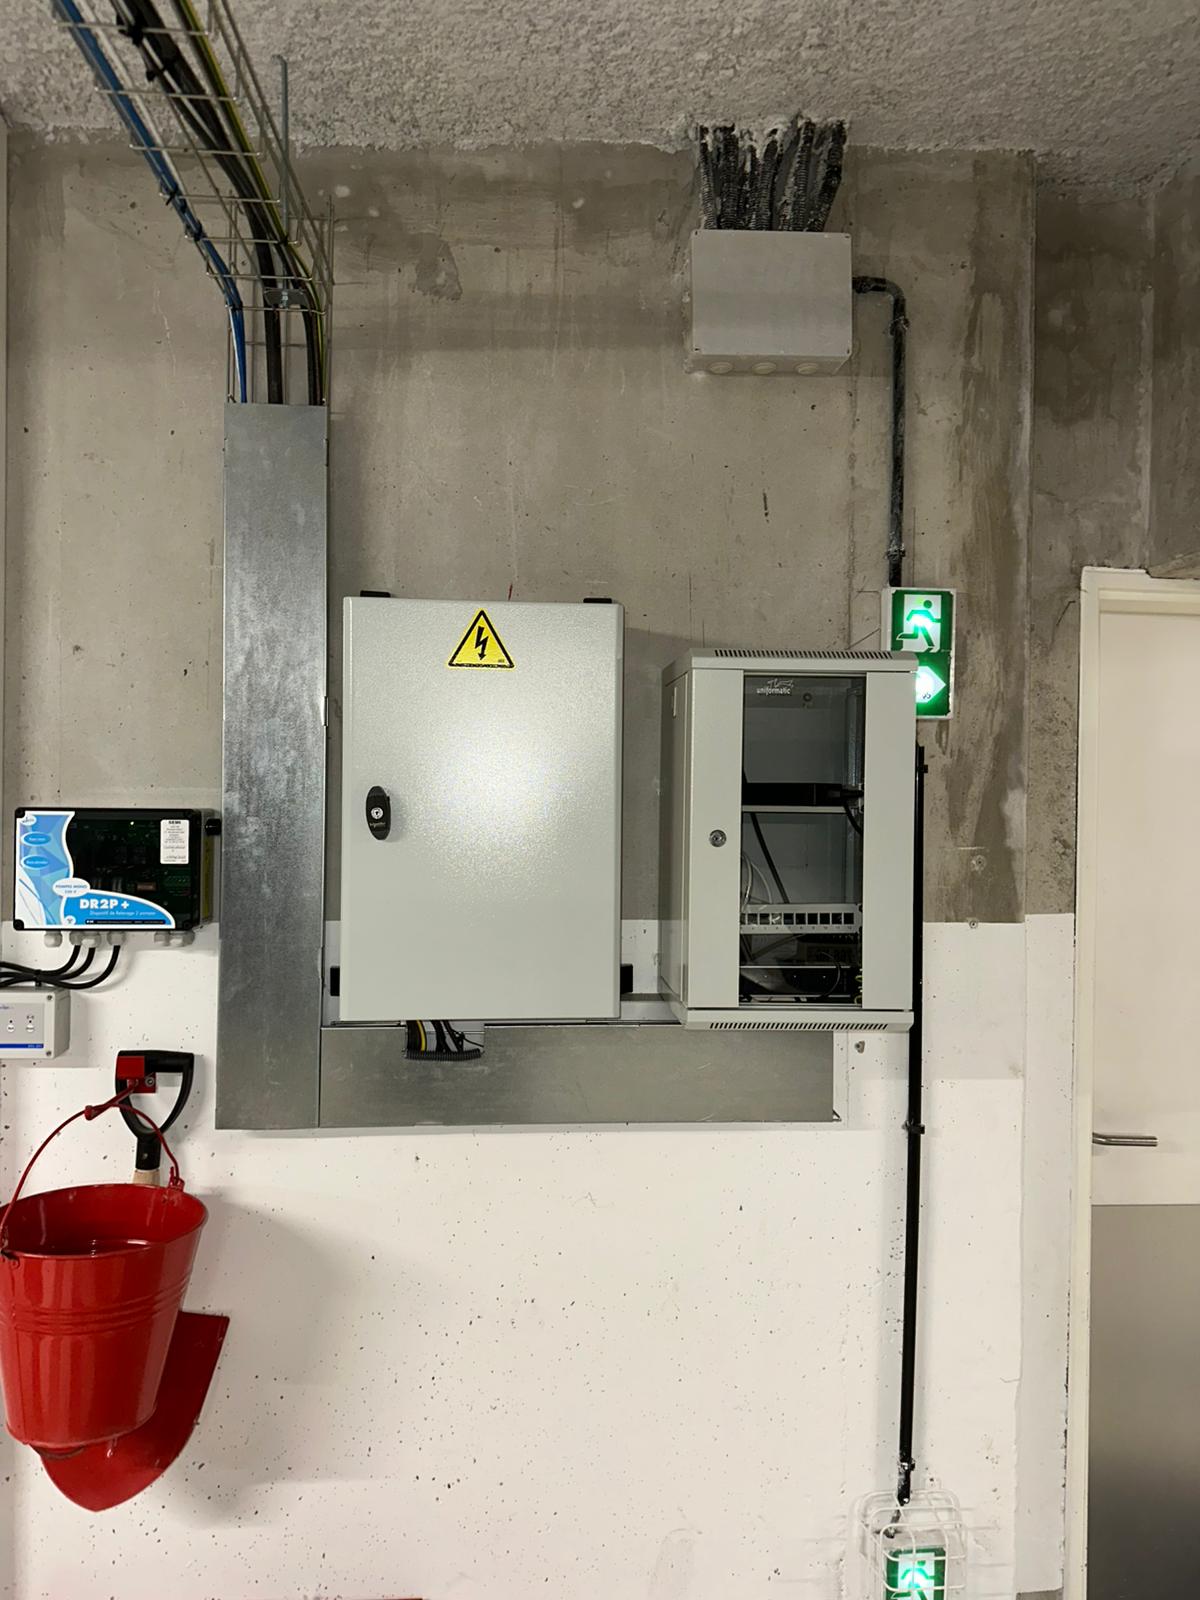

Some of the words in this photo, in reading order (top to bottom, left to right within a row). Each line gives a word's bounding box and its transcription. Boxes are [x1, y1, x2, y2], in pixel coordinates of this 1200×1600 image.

[756, 686, 791, 696] uniformatic
[80, 899, 118, 910] DR2P
[121, 901, 130, 910] +
